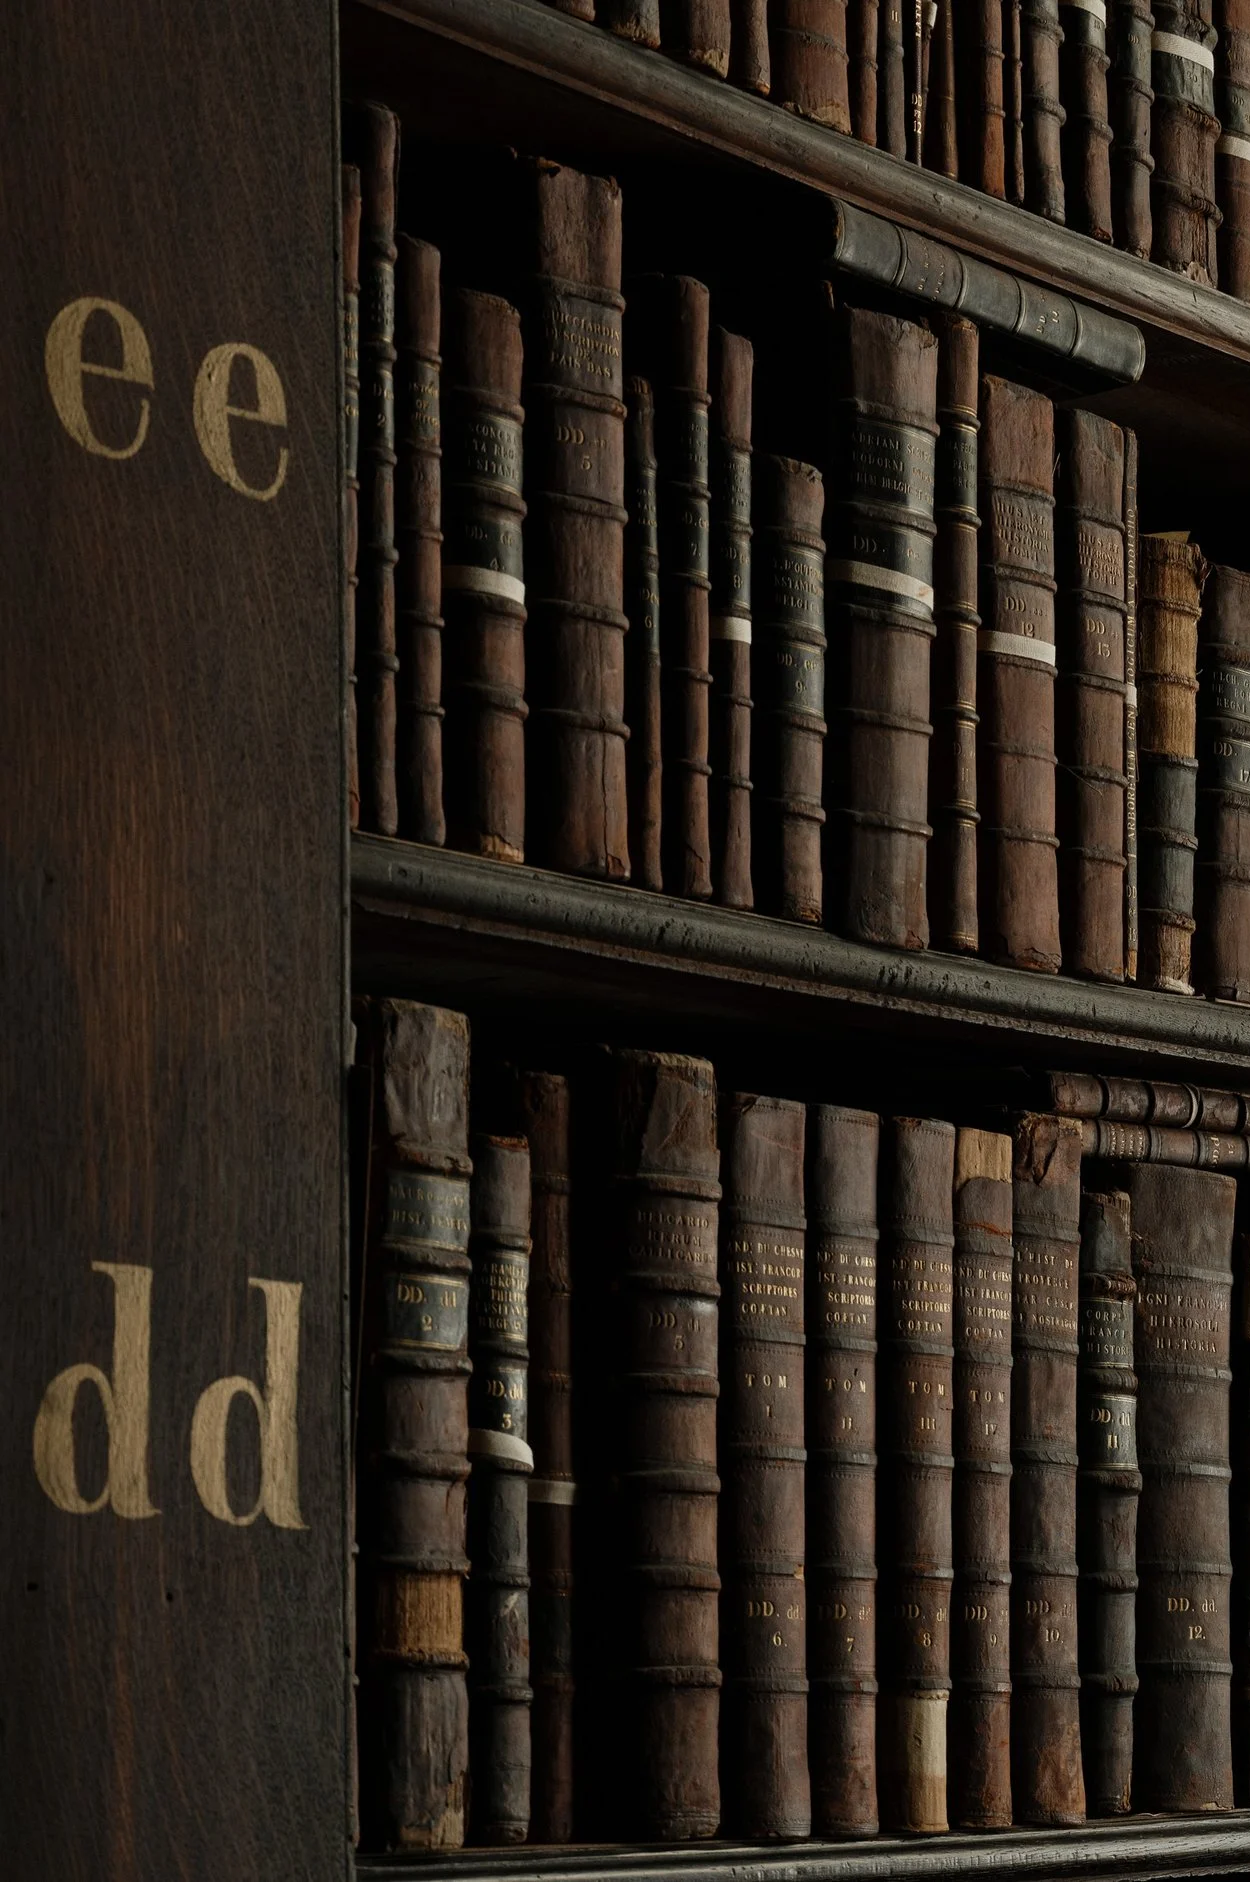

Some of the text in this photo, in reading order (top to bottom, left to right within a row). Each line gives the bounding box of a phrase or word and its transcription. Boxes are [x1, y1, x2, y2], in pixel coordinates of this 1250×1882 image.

[1127, 600, 1136, 609] A
[1127, 749, 1137, 841] ARBORETUM
[757, 1242, 771, 1255] DU
[840, 1252, 850, 1264] DU
[914, 1259, 927, 1271] DU
[978, 1267, 990, 1279] DU
[397, 1283, 428, 1303] DD.
[741, 1283, 798, 1298] SCRIPTORES
[827, 1291, 875, 1306] SCRIPTORES
[900, 1300, 952, 1313] SCRIPTORES
[966, 1306, 1011, 1321] SCRIPTORES
[1155, 1337, 1218, 1353] HISTORIA
[746, 1600, 780, 1617] DD.
[1166, 1597, 1218, 1613] DD. dd.
[772, 1631, 788, 1647] 6.
[1045, 1628, 1064, 1644] 10.
[1187, 1625, 1206, 1641] 12.
[846, 1637, 860, 1653] 7.
